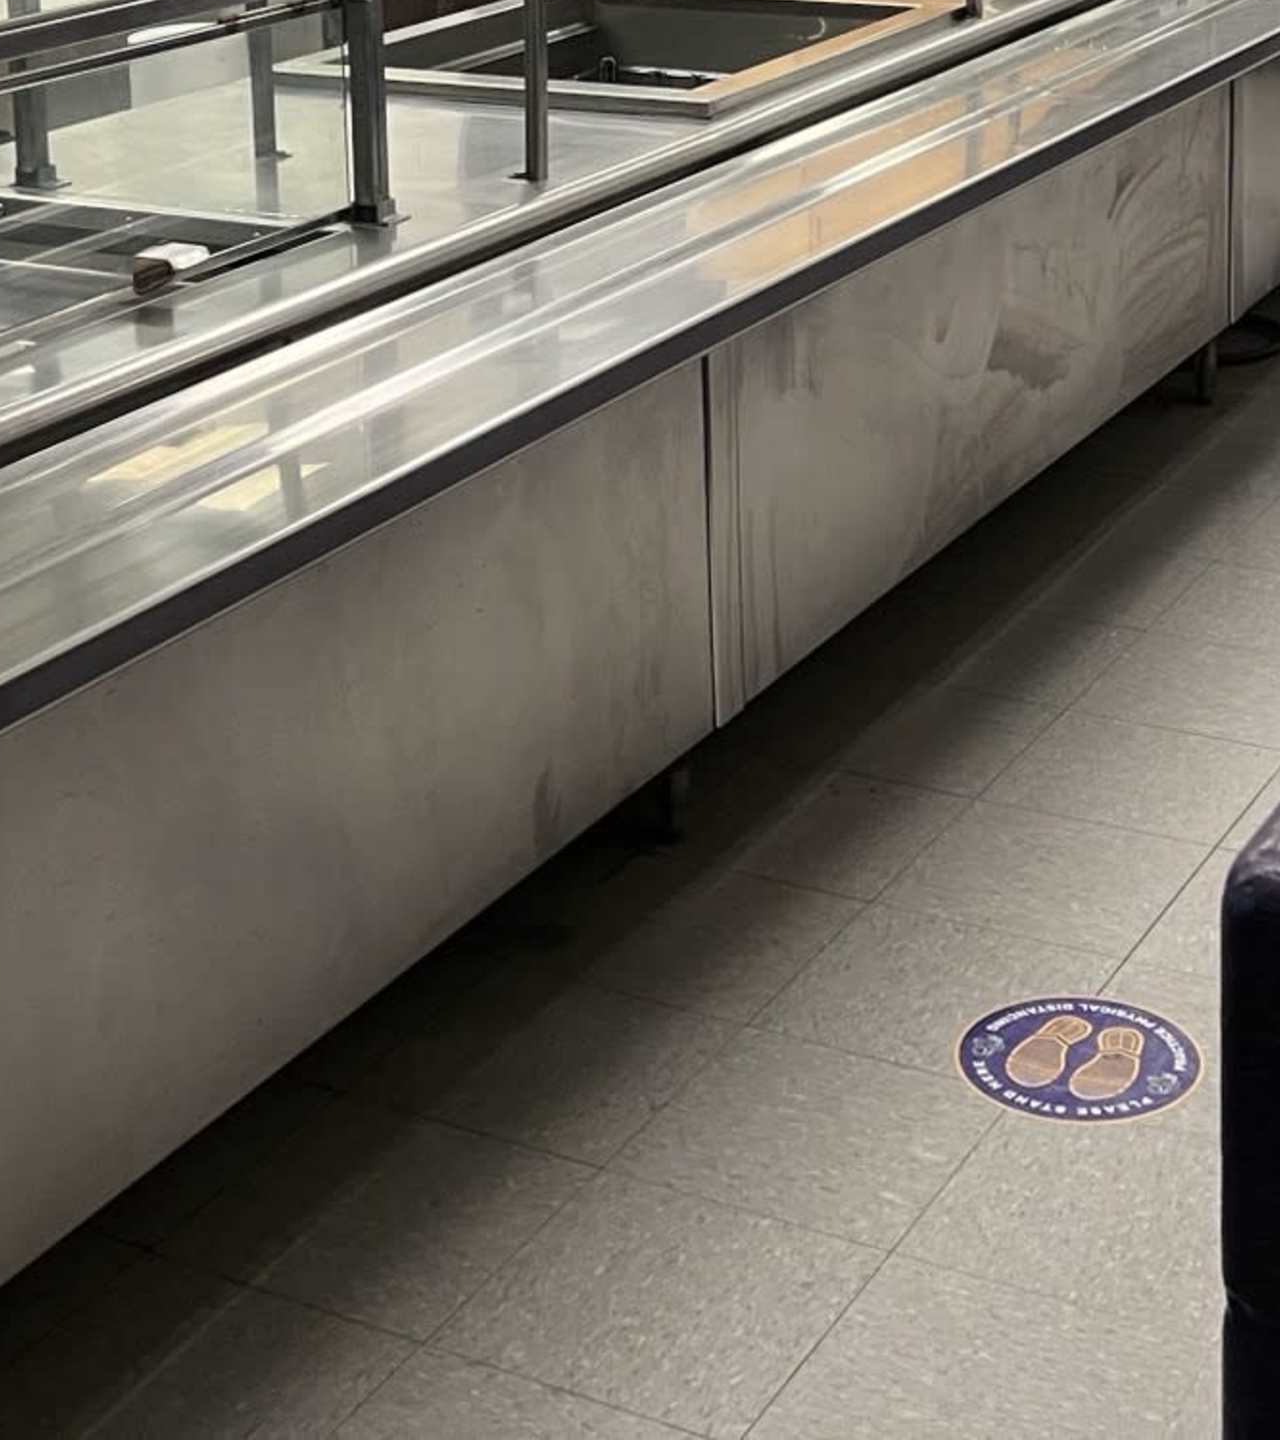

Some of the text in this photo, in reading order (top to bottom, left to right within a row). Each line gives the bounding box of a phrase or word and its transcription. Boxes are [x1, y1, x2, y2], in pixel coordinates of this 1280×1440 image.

[986, 1003, 1074, 1032] DISTANCING
[1076, 1003, 1156, 1030] PHYSICAL
[1003, 1089, 1066, 1114] STAND
[1076, 1095, 1152, 1115] PLEASE
